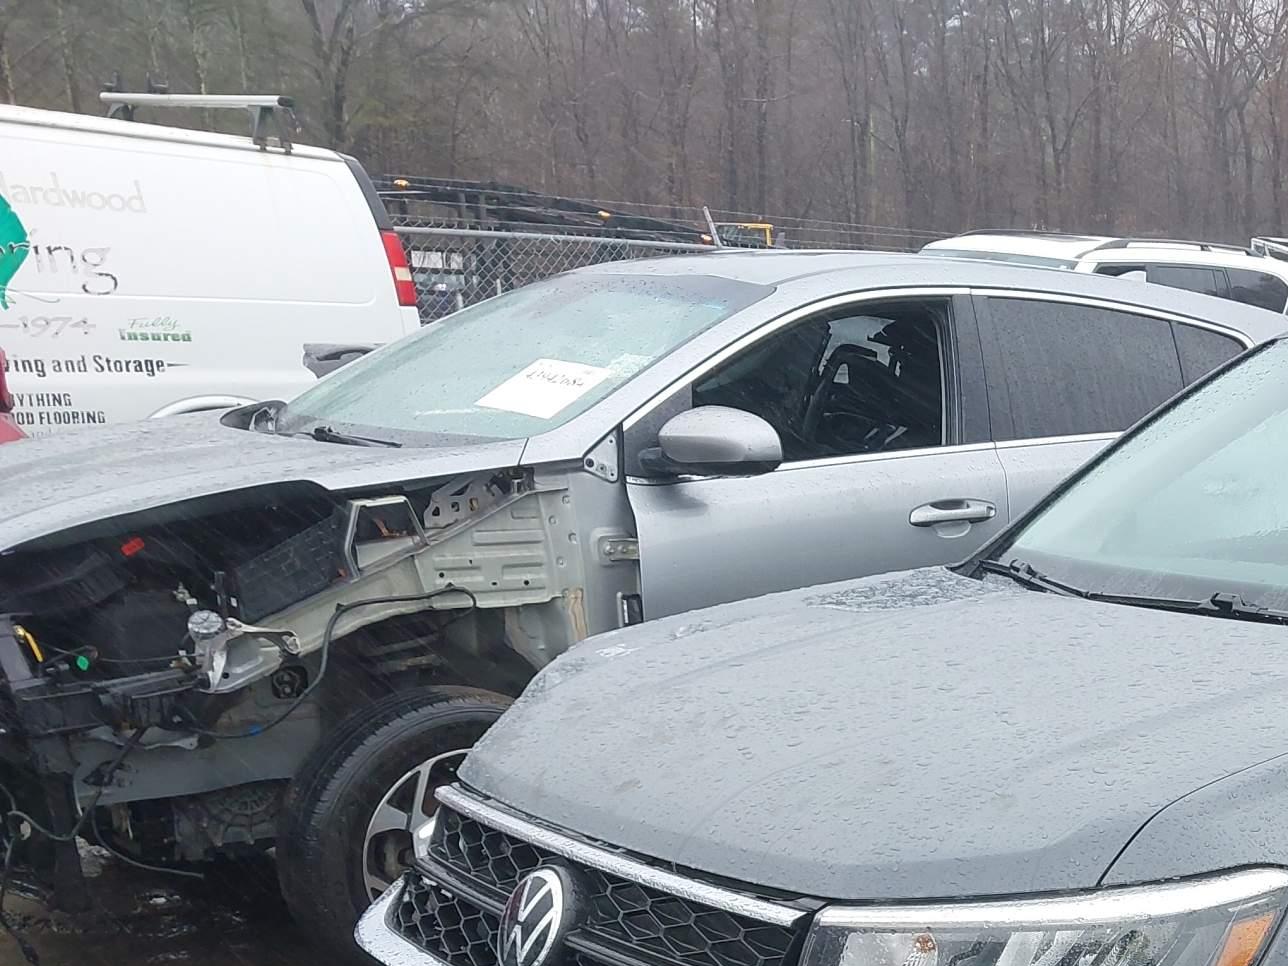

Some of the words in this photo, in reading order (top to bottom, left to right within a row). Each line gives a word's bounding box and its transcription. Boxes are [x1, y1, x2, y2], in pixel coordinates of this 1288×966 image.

[118, 328, 192, 342] Insured
[52, 356, 88, 373] and
[93, 355, 166, 377] Storage
[12, 412, 35, 426] OD
[39, 411, 106, 425] FLOORING
